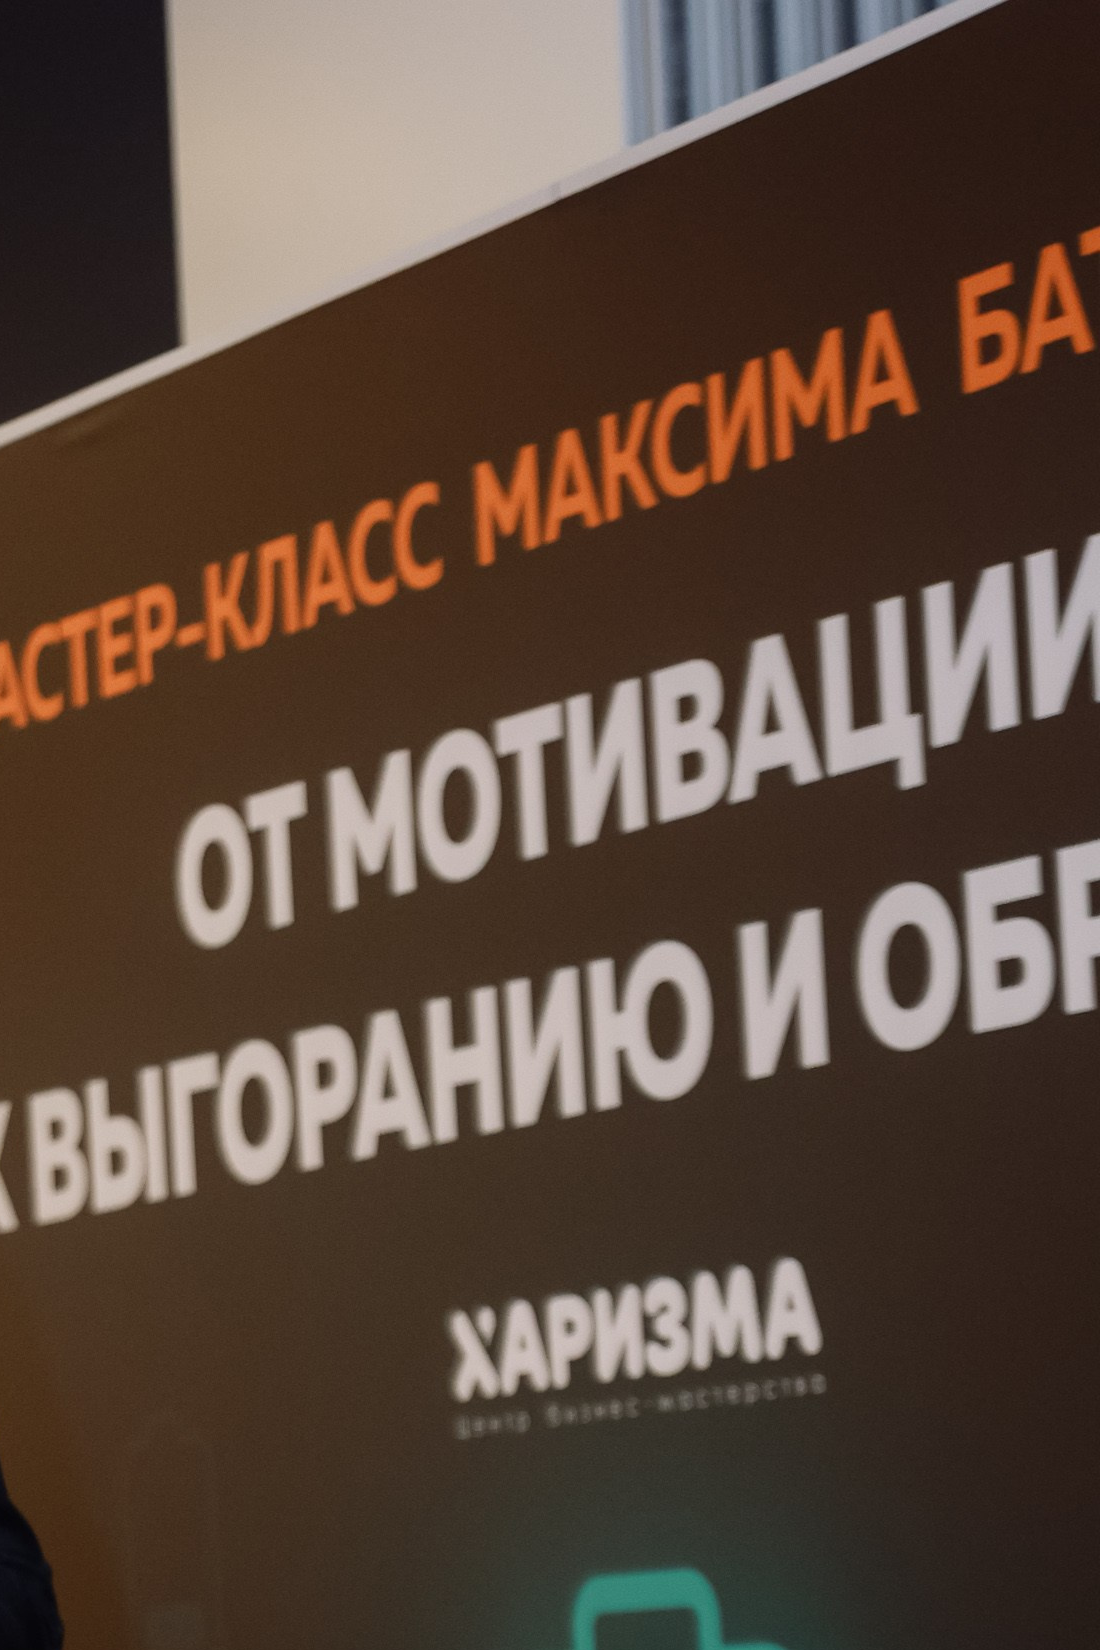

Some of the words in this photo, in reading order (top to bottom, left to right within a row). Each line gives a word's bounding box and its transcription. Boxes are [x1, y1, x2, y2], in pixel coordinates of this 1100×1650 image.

[472, 308, 919, 567] МАКСИМА
[176, 781, 307, 948] ОТ
[327, 533, 1100, 911] МОТИВАЦИИ
[28, 940, 713, 1225] ВЫГОРАНИЮ
[739, 908, 830, 1080] И
[449, 1257, 823, 1401] ХАРИЗМА
